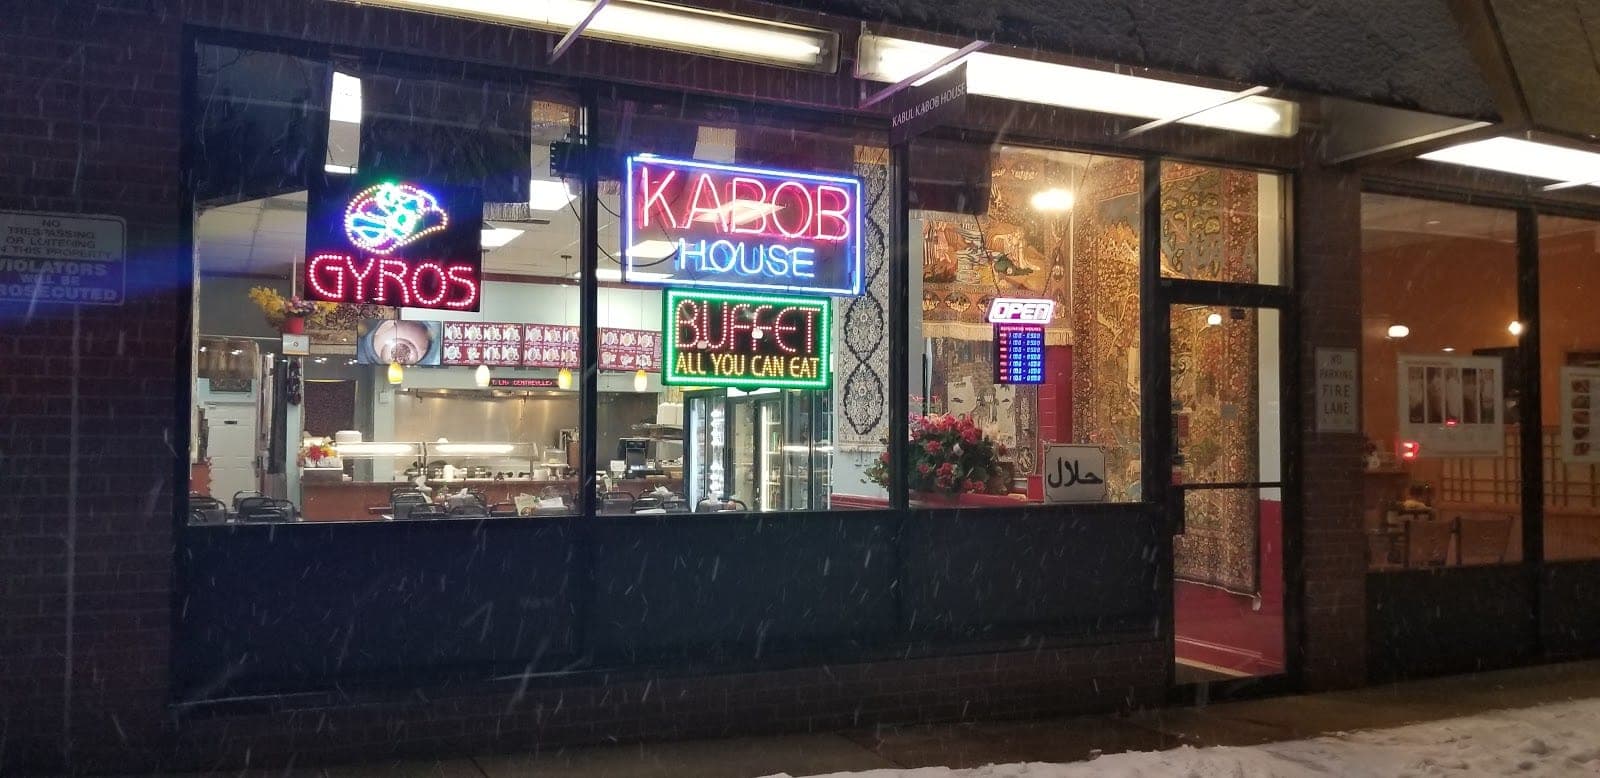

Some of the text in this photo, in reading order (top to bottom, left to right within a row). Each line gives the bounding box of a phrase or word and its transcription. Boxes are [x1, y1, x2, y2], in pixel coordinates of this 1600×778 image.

[892, 82, 966, 127] KABUL KABOB HOUSE
[639, 166, 851, 241] KABOB
[42, 218, 60, 228] NO
[8, 225, 95, 240] TRESPASSING
[6, 236, 96, 250] OR LOITERING
[14, 245, 41, 256] THIS
[678, 237, 816, 278] HOUSE
[19, 273, 80, 286] WILL BE
[308, 253, 477, 308] GYROS
[993, 301, 1050, 320] OPEN
[674, 299, 821, 354] BUFFET
[674, 352, 820, 379] ALL YOU CAN EAT
[1328, 353, 1343, 366] NO
[1322, 384, 1351, 398] FIRE
[1323, 400, 1350, 415] LANE
[1048, 456, 1103, 488] حلال
